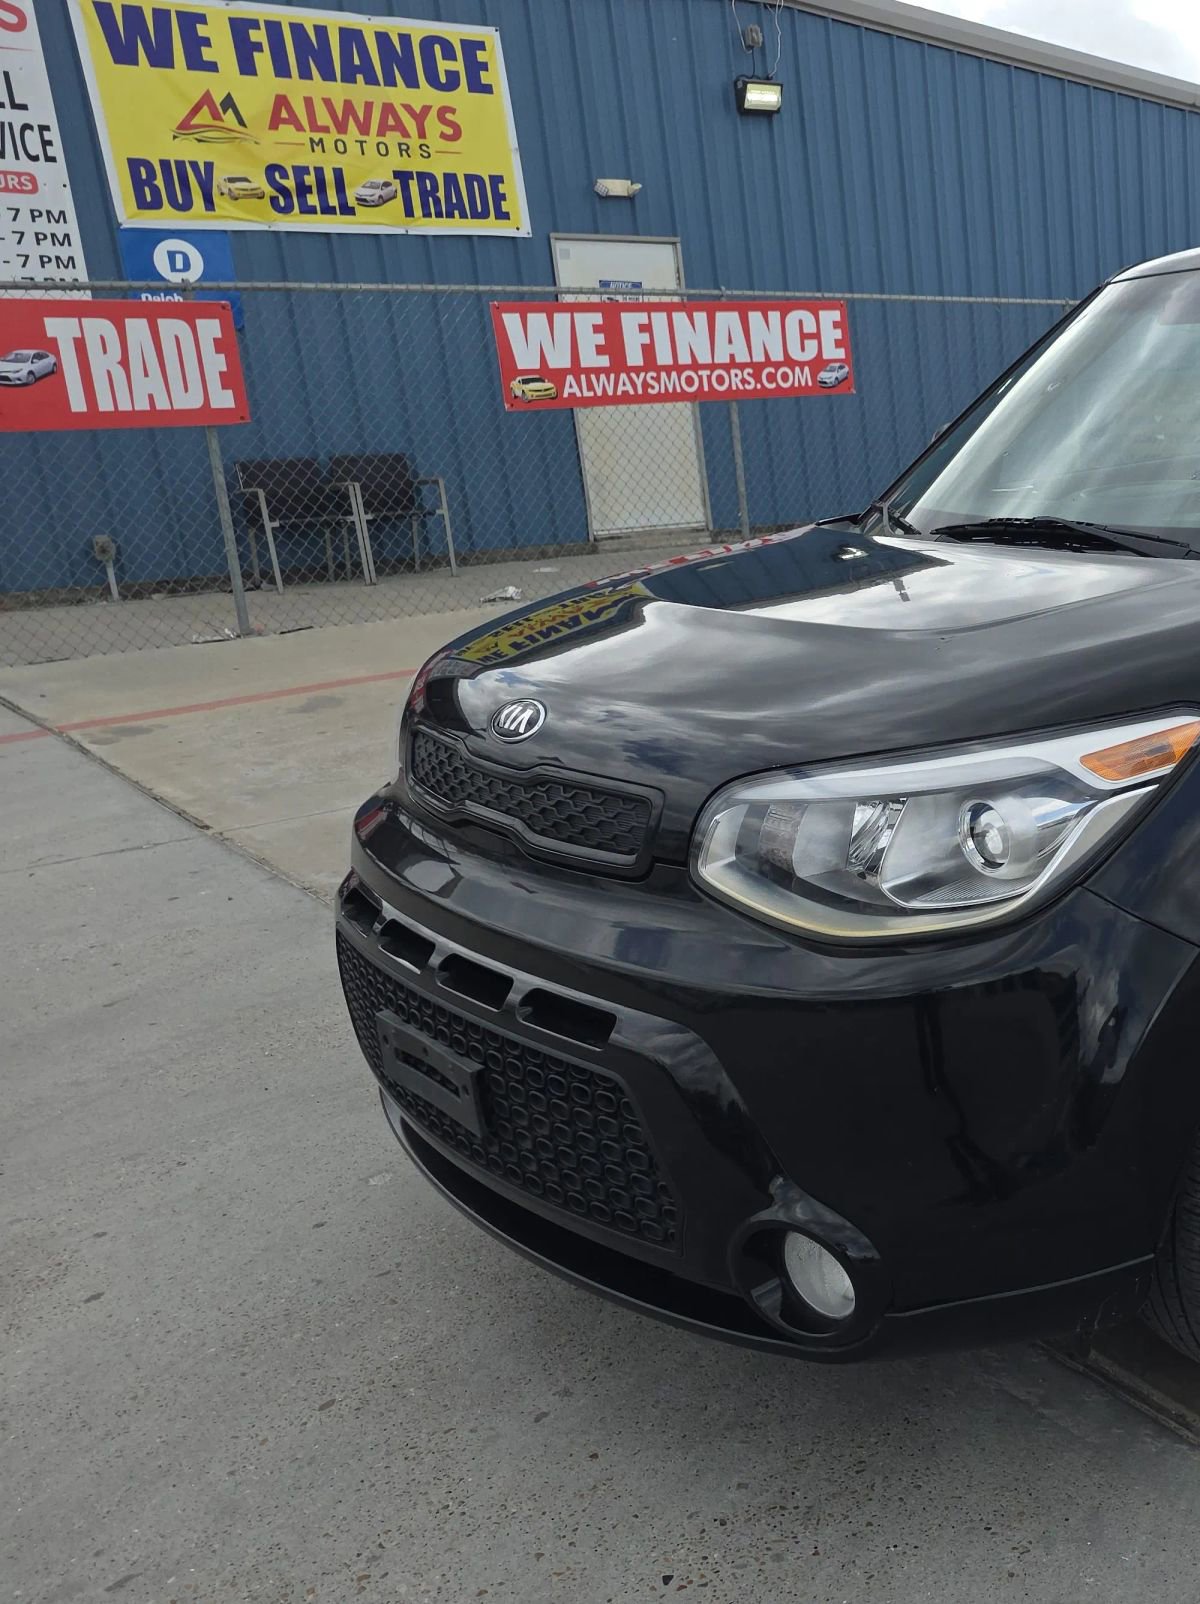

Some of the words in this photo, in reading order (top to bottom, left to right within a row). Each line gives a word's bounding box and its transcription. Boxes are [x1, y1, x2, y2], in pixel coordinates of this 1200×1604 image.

[92, 0, 220, 73] WE
[228, 16, 495, 95] FINANCE
[268, 93, 463, 142] ALWAYS
[308, 137, 433, 159] MOTORS
[126, 158, 217, 213] BUY
[264, 163, 356, 217] SELL
[392, 170, 511, 221] TRADE
[6, 206, 20, 222] 7
[29, 208, 68, 225] PM
[11, 230, 25, 245] 7
[34, 231, 72, 247] PM
[16, 253, 30, 268] 7
[38, 254, 76, 270] PM
[501, 311, 611, 370] WE
[620, 309, 846, 366] FINANCE
[43, 317, 236, 413] TRADE
[562, 366, 813, 399] ALWAYSMOTORS.COM
